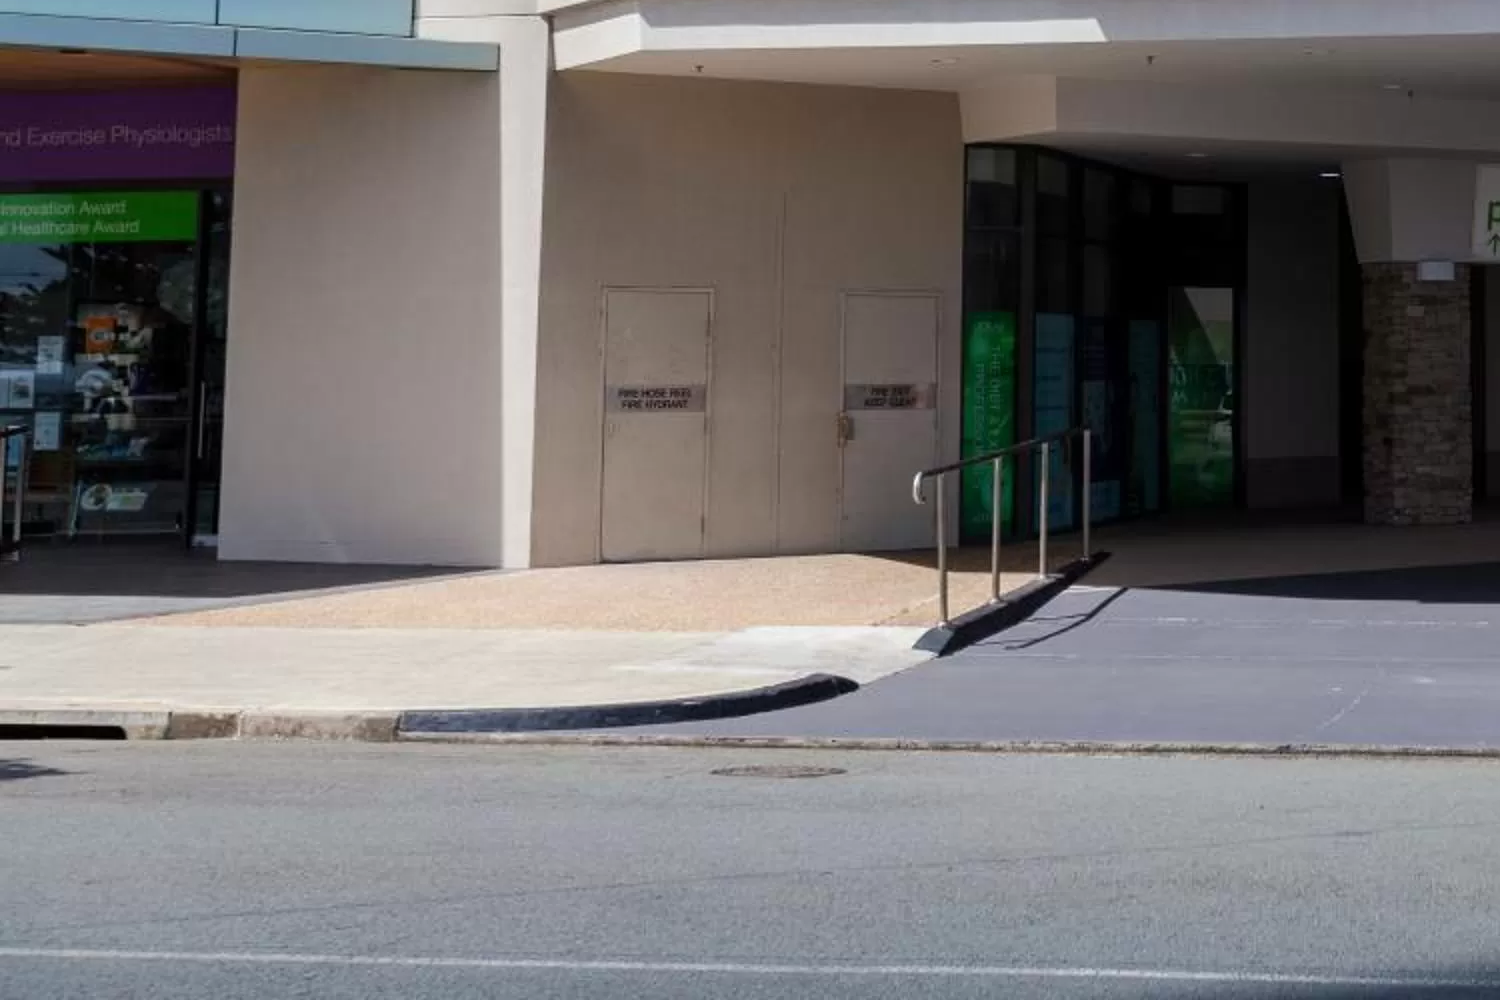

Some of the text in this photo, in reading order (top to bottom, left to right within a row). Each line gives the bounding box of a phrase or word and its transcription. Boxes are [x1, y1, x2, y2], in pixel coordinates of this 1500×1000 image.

[27, 126, 106, 148] Exercise
[111, 123, 233, 149] Physiologists
[79, 199, 128, 216] Award
[93, 218, 141, 234] Award
